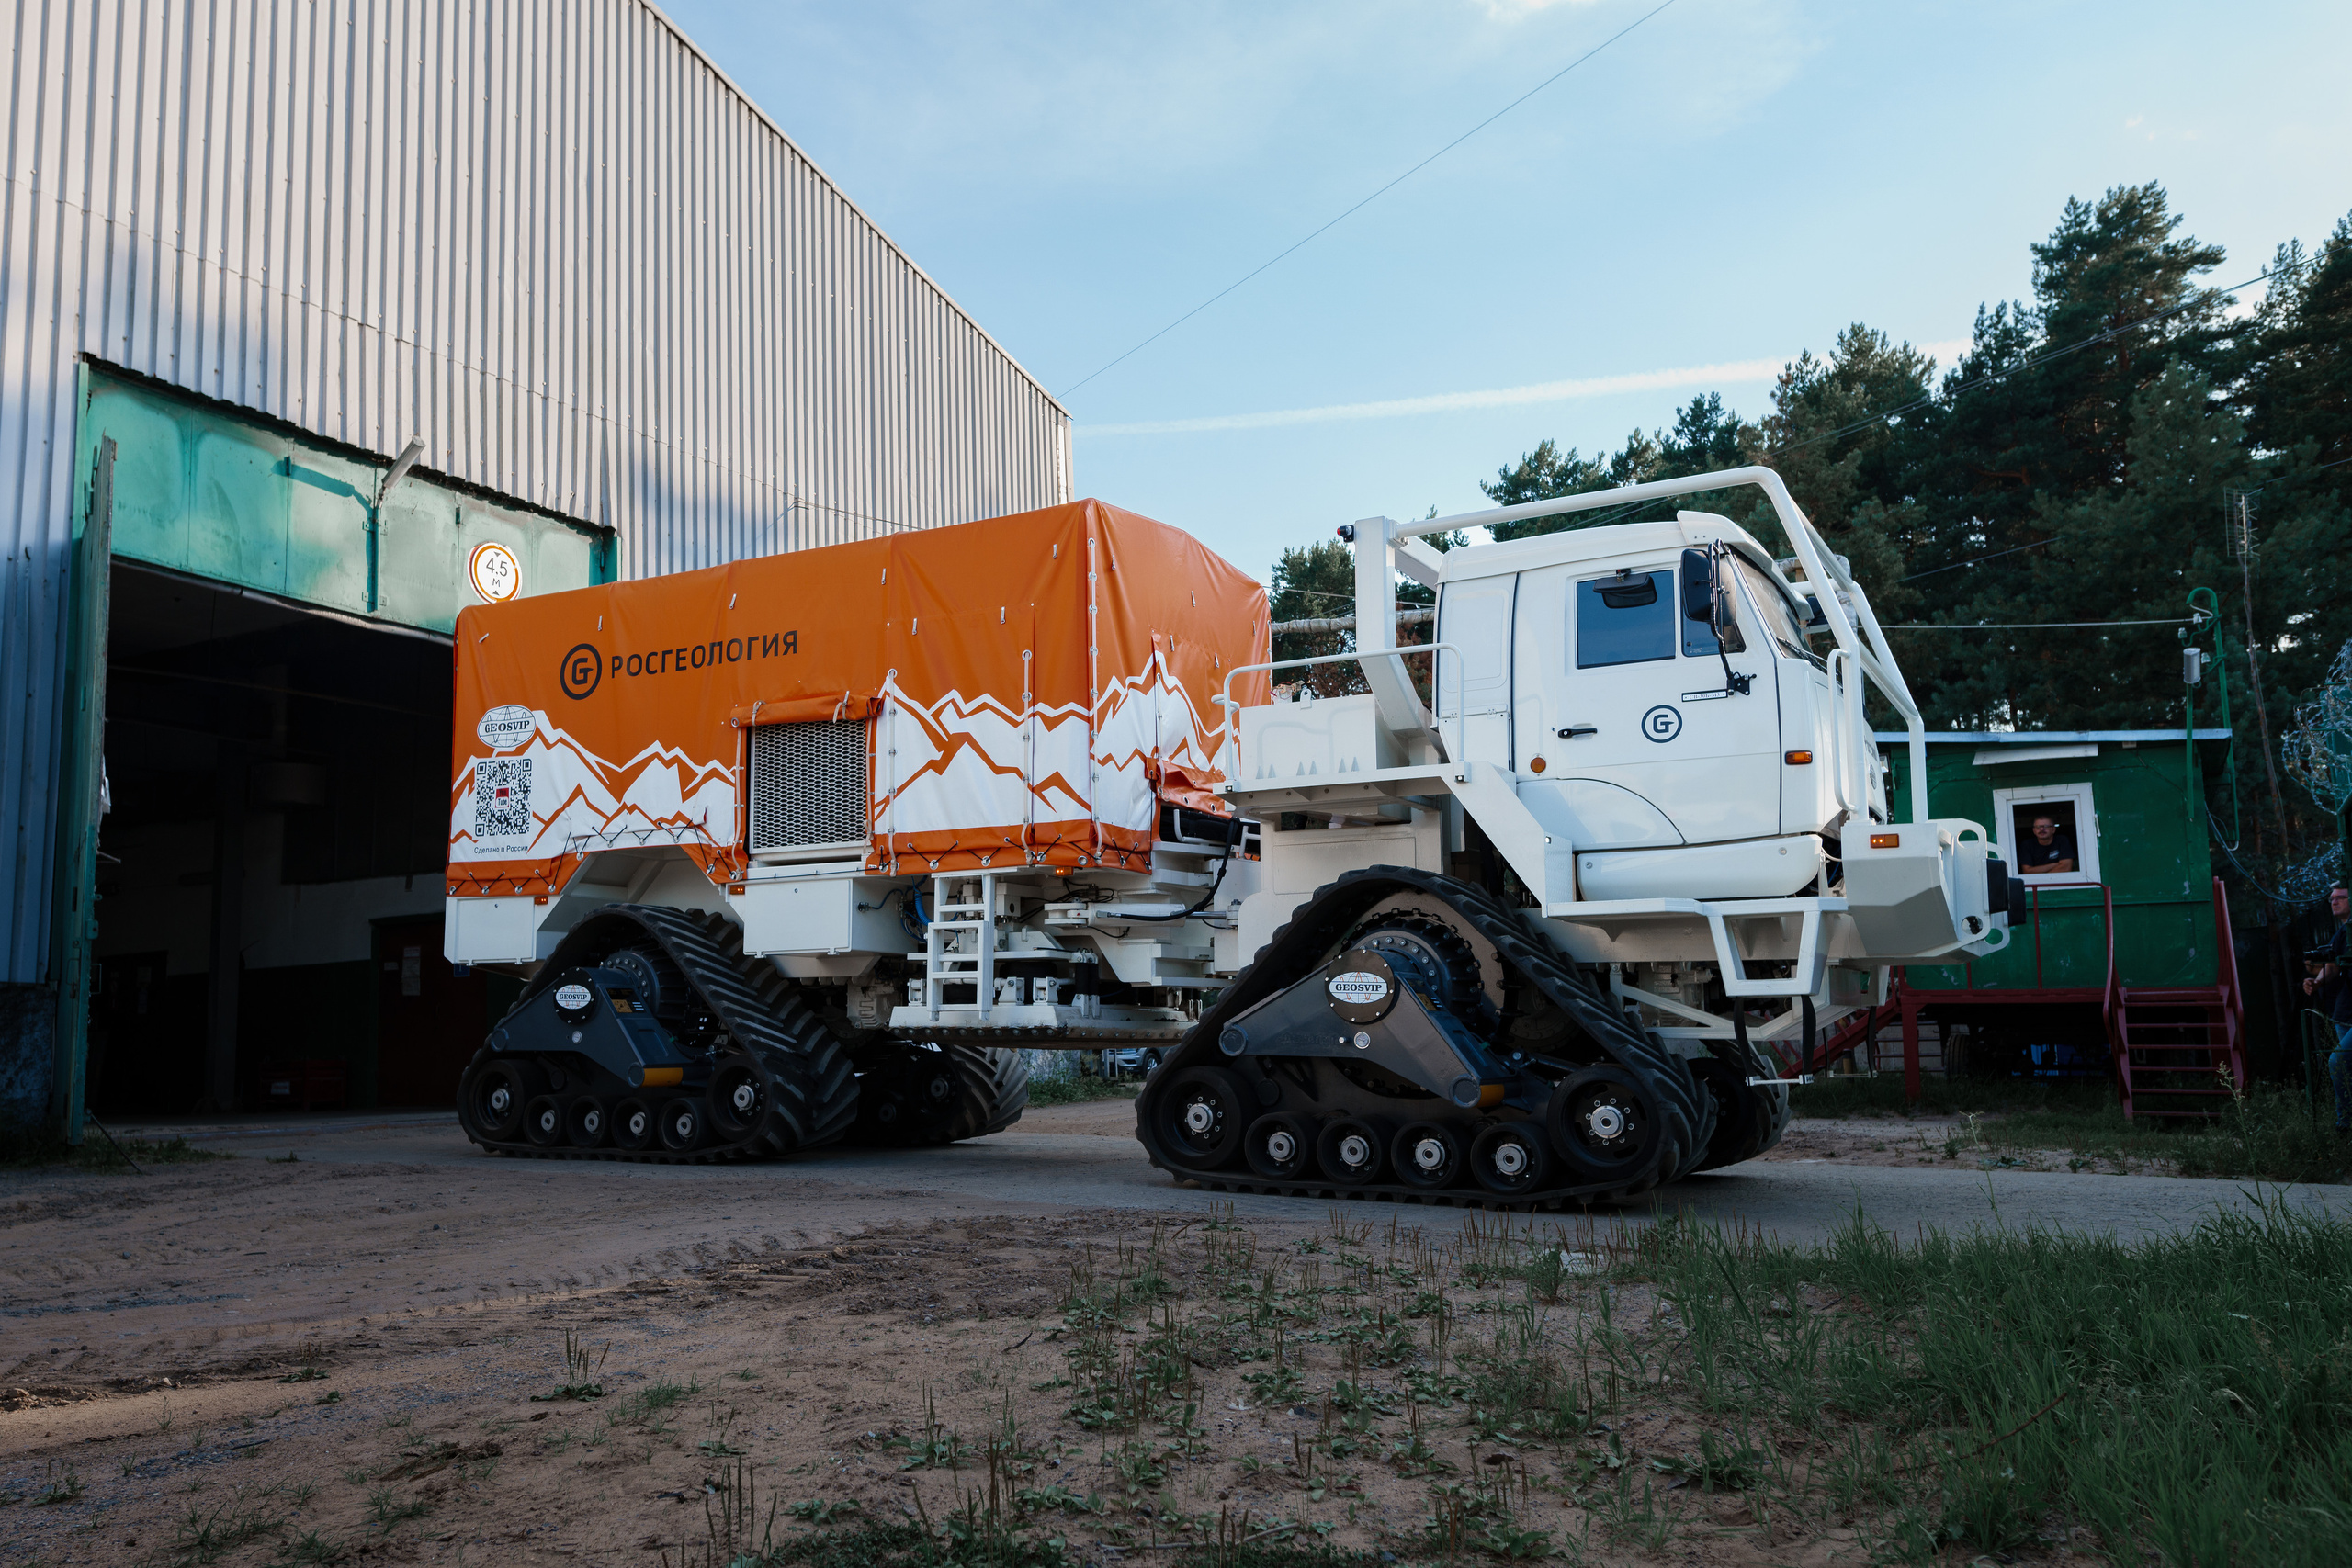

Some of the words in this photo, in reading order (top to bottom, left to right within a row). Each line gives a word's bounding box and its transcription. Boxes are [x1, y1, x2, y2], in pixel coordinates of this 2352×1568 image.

[486, 558, 508, 577] 4.5
[611, 629, 798, 679] РОСГЕОЛОГИЯ
[484, 720, 530, 733] GEOSVIP
[473, 846, 500, 854] Сделано
[1335, 983, 1382, 991] GEOSVIP
